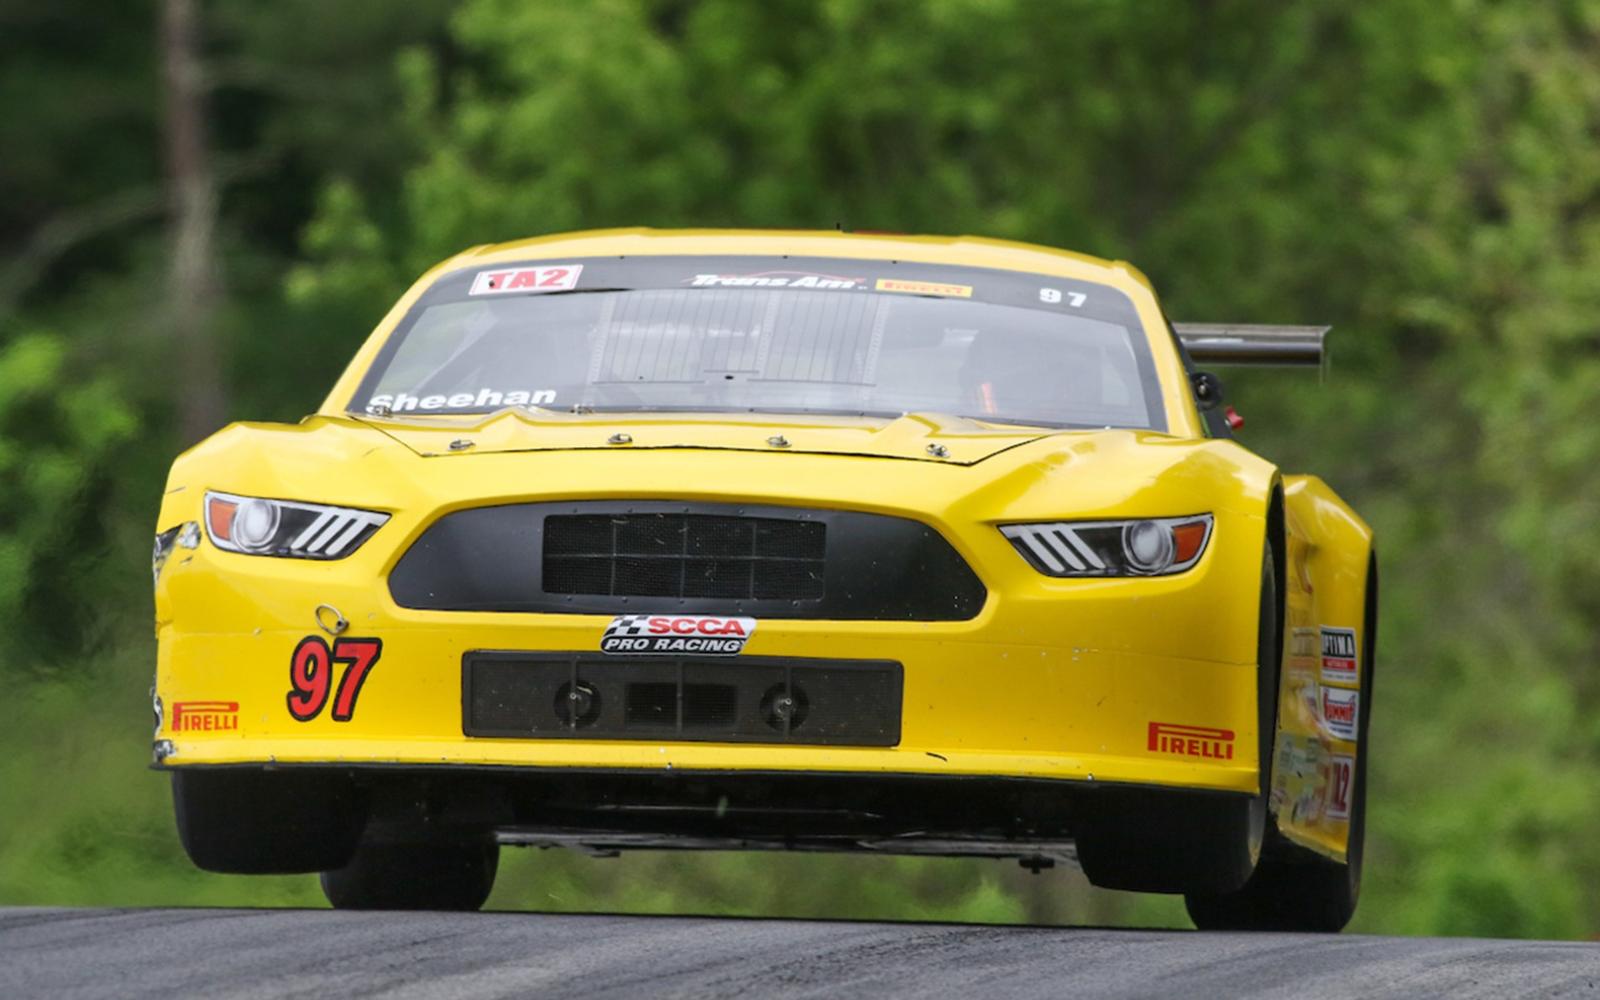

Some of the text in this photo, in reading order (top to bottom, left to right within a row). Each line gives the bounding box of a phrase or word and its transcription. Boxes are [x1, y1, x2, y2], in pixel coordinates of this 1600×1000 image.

[488, 269, 569, 289] TA2
[692, 274, 856, 289] Trans Am
[1039, 288, 1087, 308] 97
[365, 389, 557, 415] Sheehan
[648, 618, 746, 636] SCCA
[604, 638, 741, 652] PRO RACING
[286, 635, 383, 722] 97
[172, 702, 239, 731] PIRELLI
[1147, 721, 1235, 760] PIRELLI
